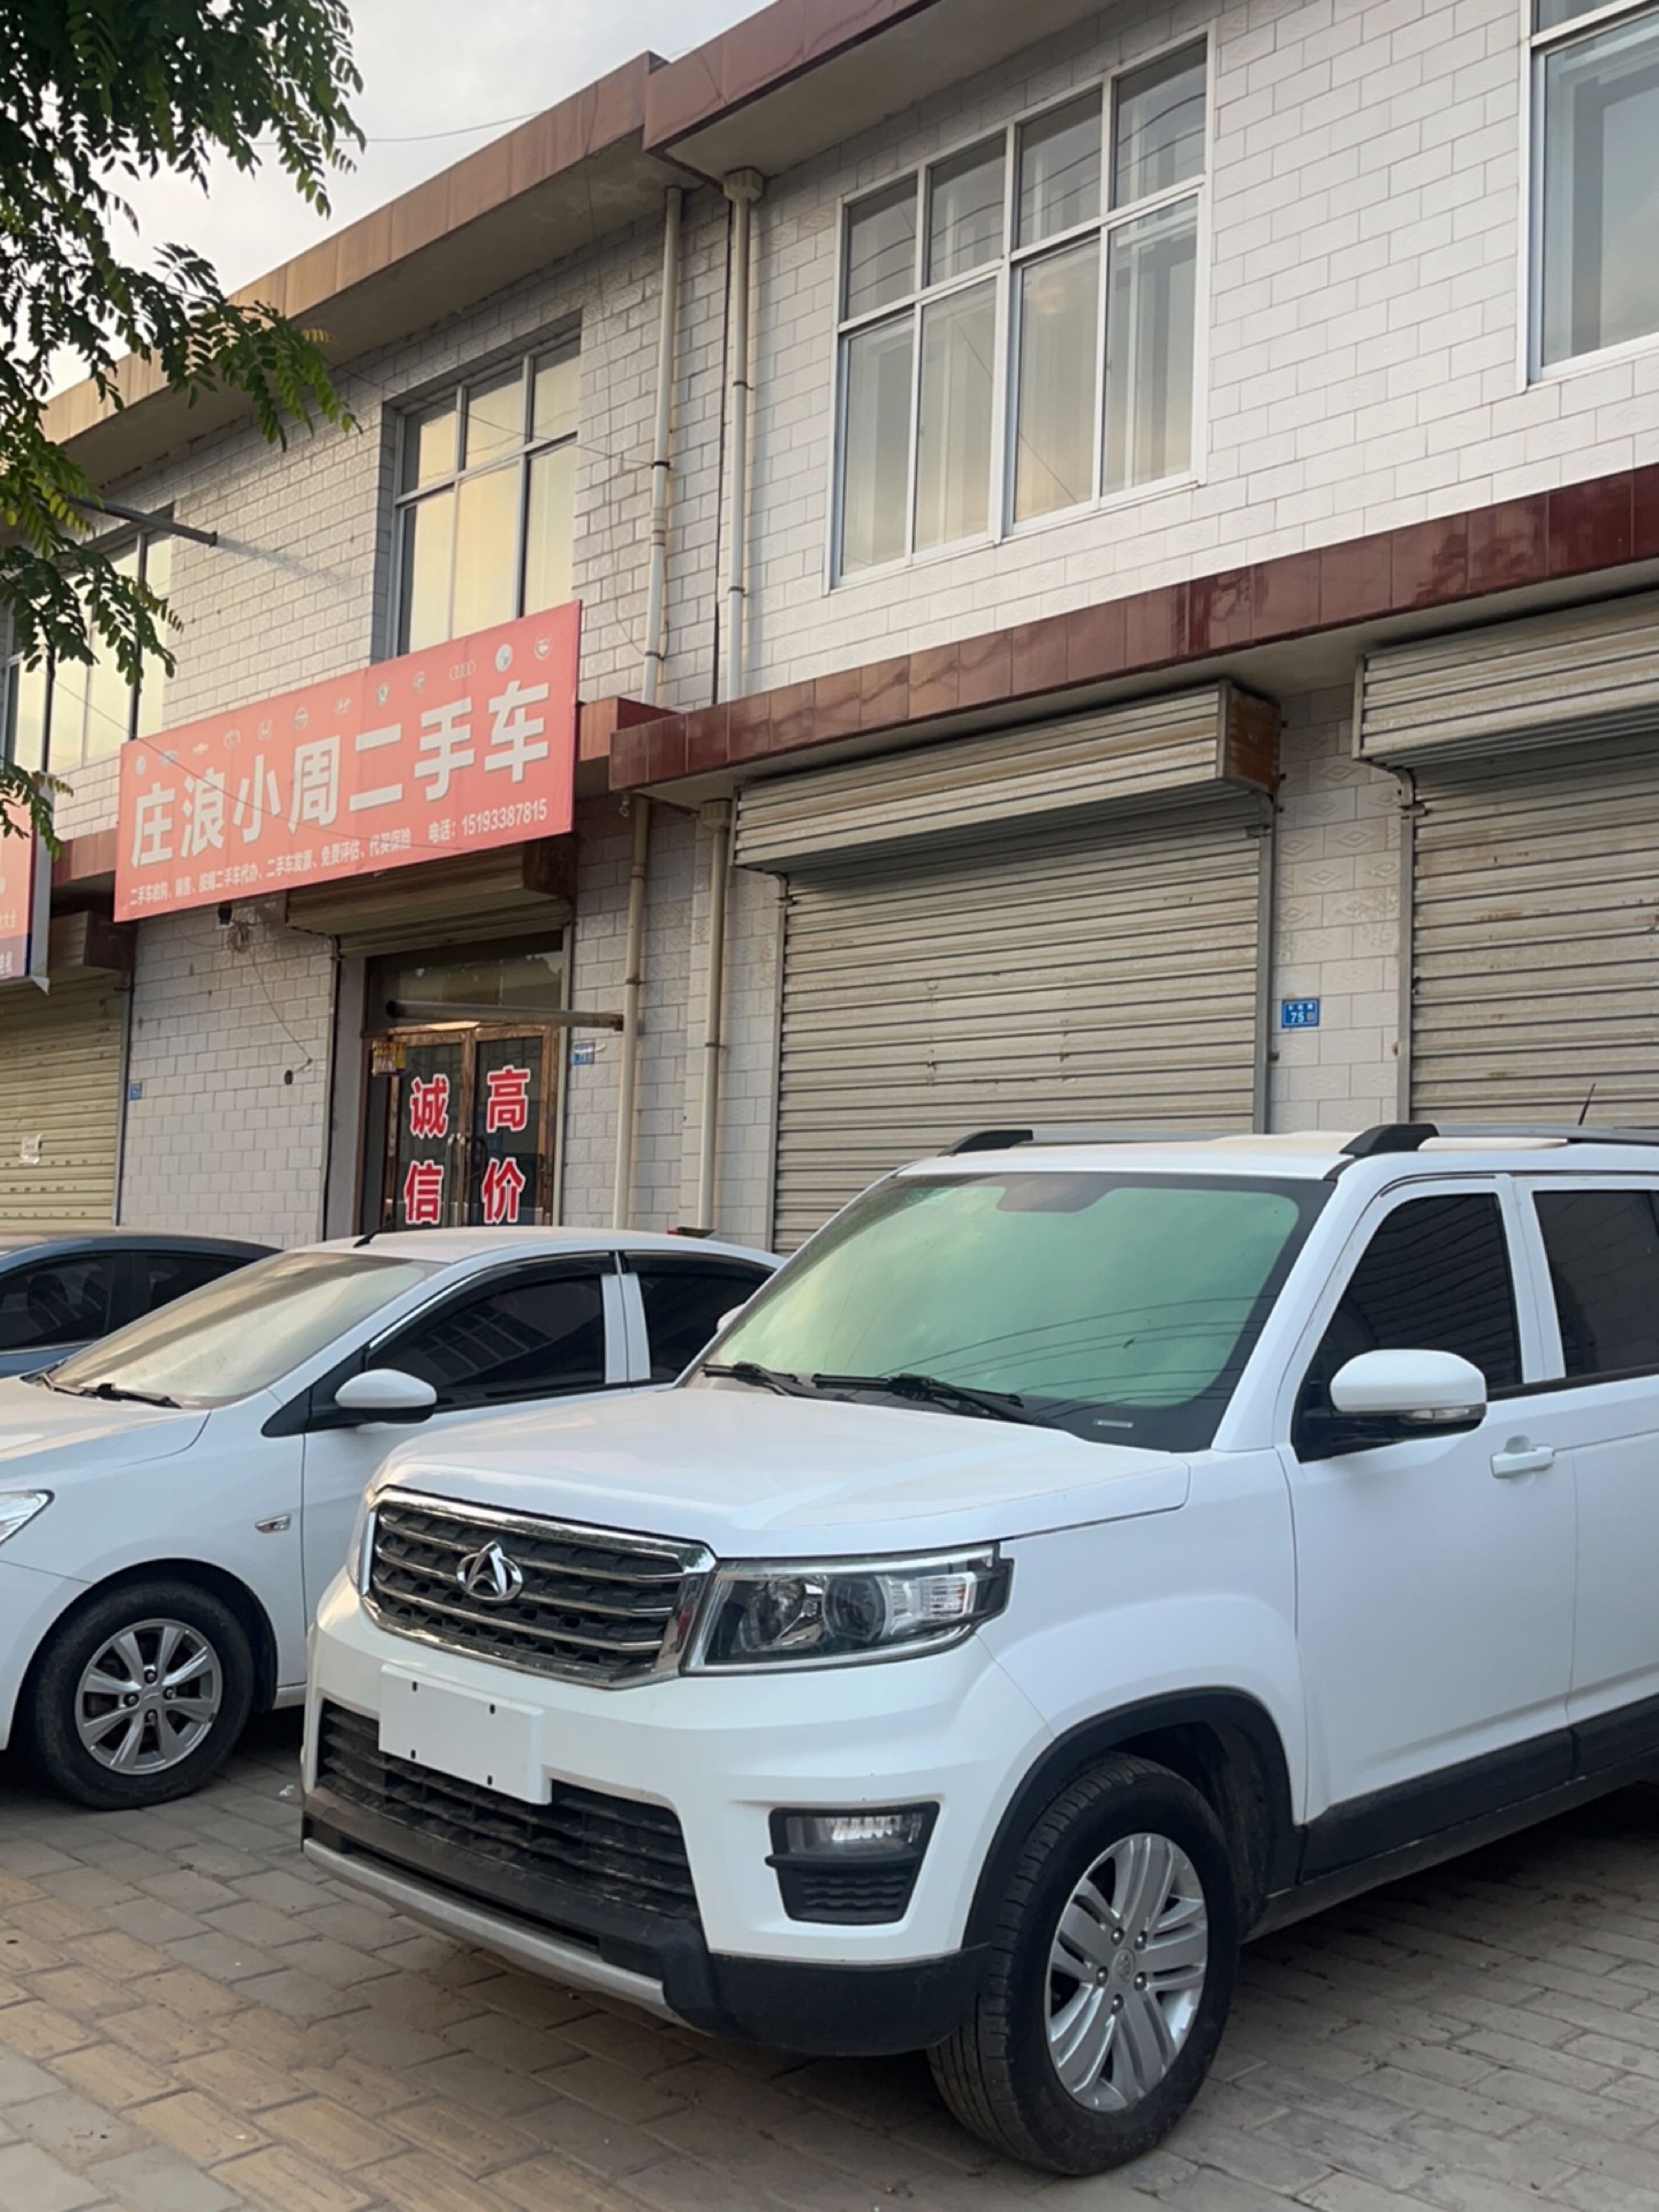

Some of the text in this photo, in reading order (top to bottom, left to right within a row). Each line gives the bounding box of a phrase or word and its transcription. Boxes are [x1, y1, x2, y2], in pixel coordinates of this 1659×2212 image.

[131, 680, 550, 869] 庄浪小周二手车
[404, 1073, 449, 1225] 诚信
[481, 1064, 531, 1224] 高价
